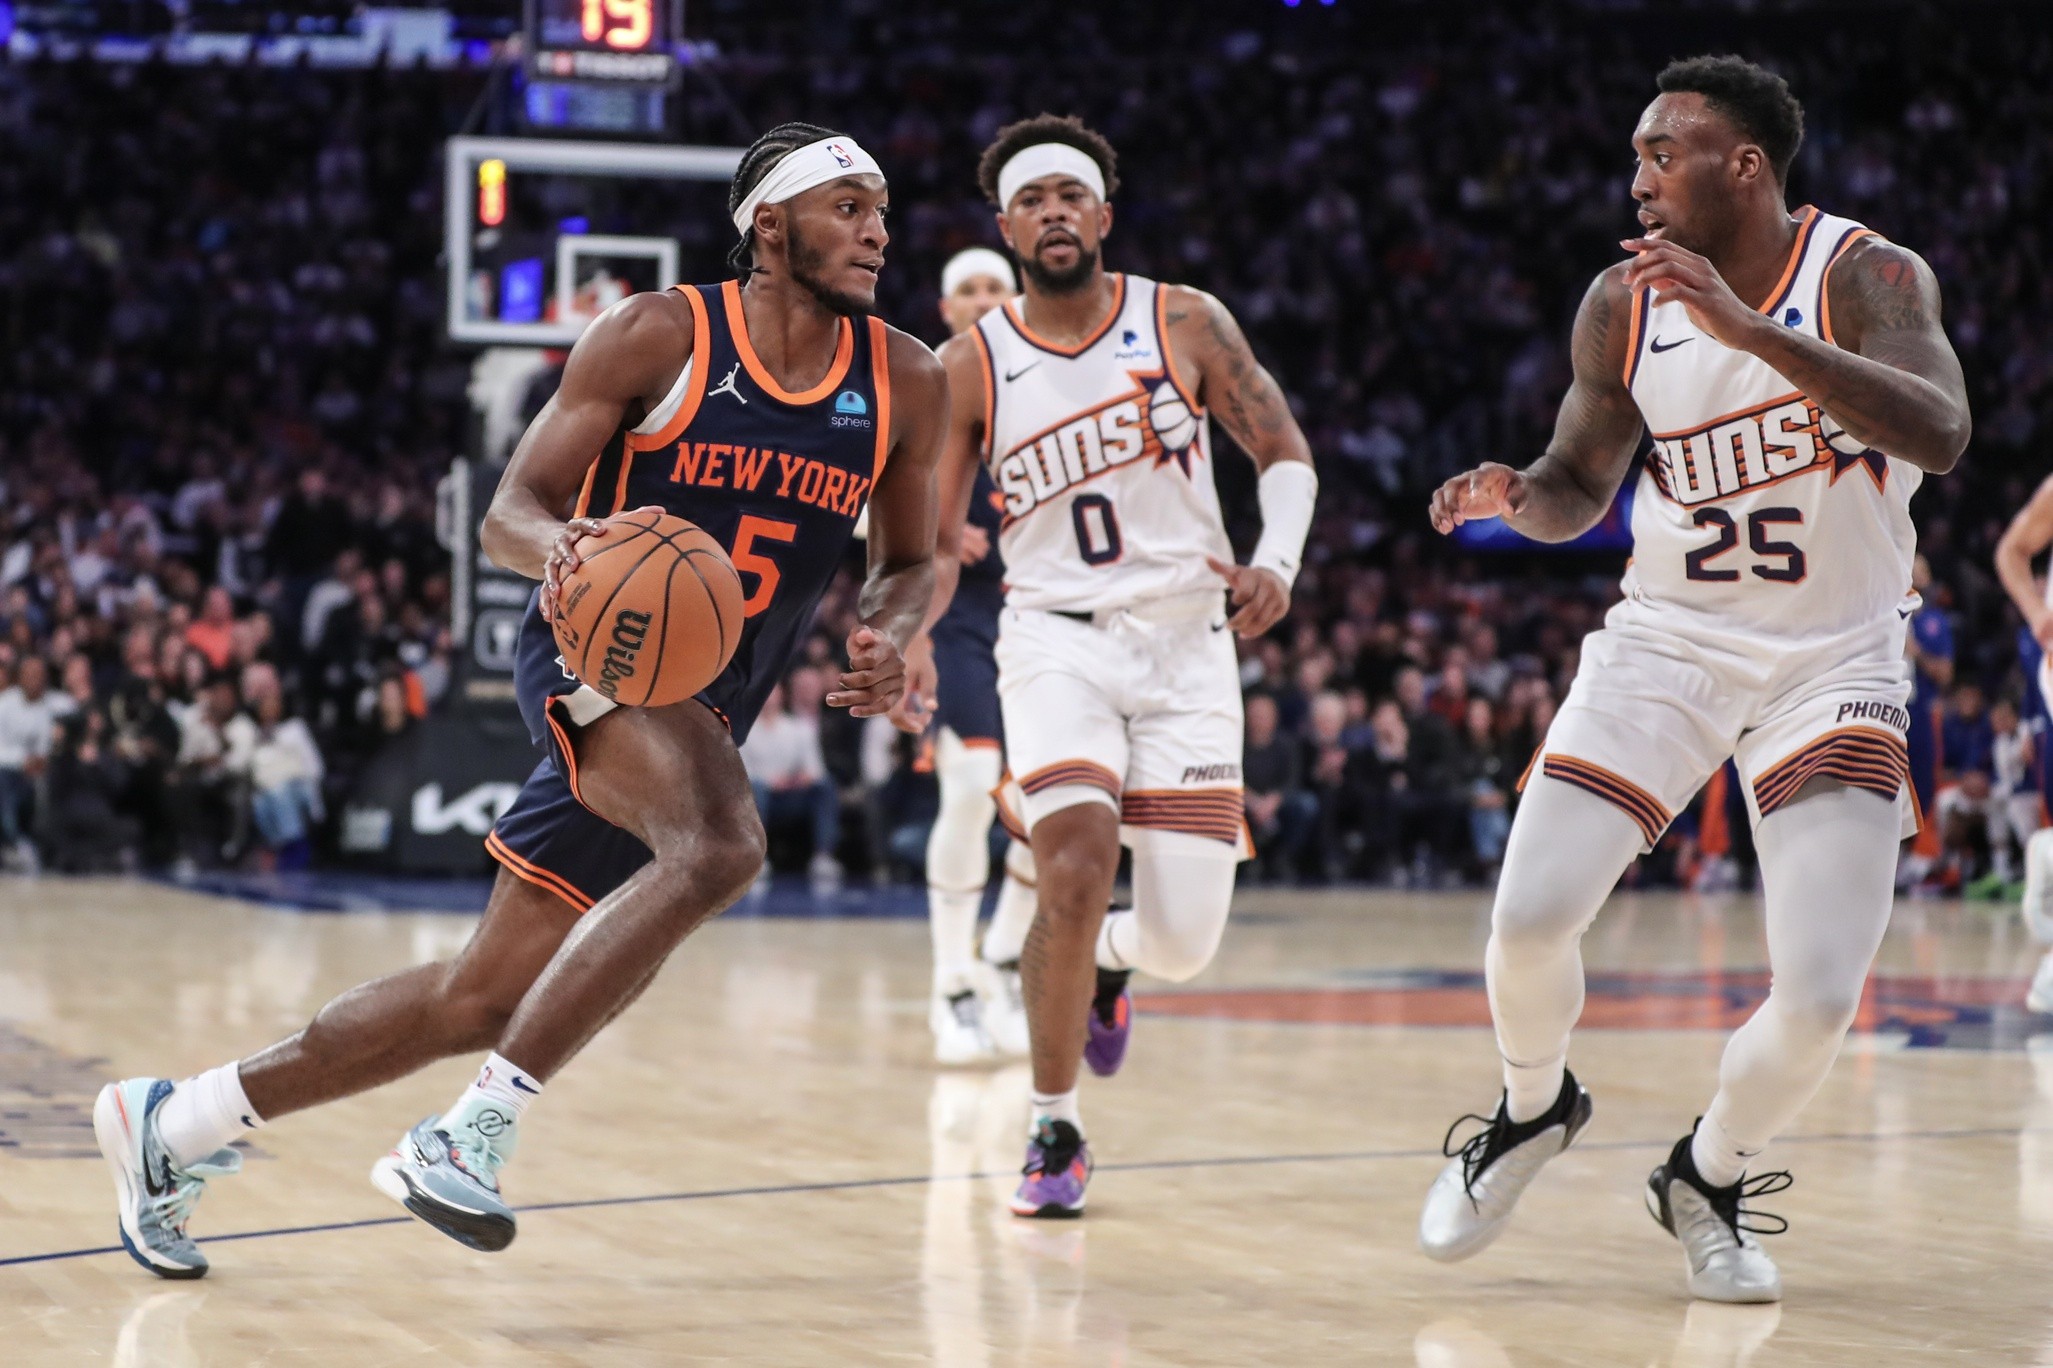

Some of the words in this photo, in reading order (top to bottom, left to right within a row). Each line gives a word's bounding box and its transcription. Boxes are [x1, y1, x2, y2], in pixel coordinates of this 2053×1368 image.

[831, 416, 871, 428] sphere
[1001, 401, 1145, 518] SUNS
[670, 442, 772, 493] NEW
[775, 453, 870, 518] YORK
[730, 513, 798, 619] 5
[1071, 493, 1123, 567] 0
[1685, 506, 1807, 584] 25
